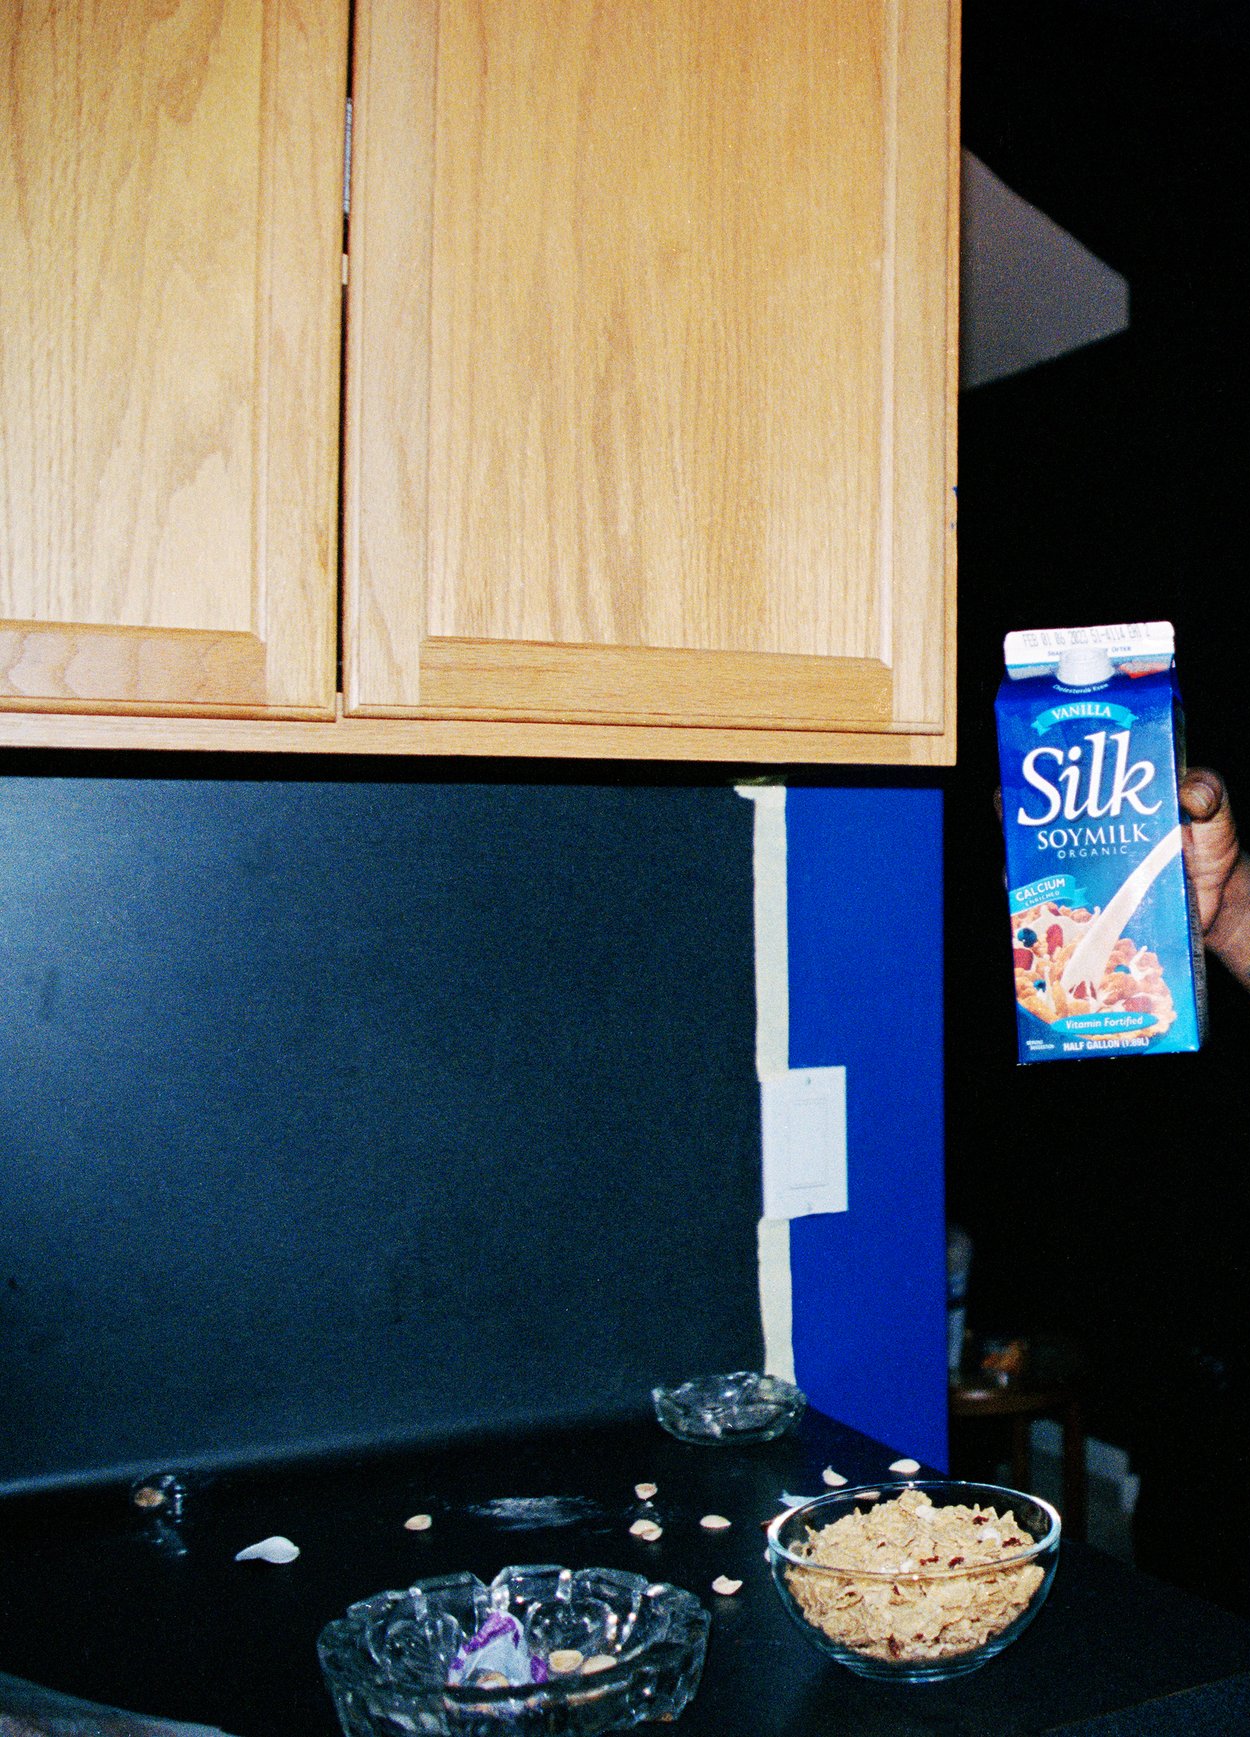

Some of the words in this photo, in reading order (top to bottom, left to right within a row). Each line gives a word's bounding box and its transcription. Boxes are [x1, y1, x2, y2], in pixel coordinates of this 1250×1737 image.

[1052, 704, 1111, 720] VANILLA
[1017, 730, 1163, 826] Silk
[1038, 823, 1151, 850] SOYMILK
[1057, 845, 1129, 860] ORGANIC
[1015, 878, 1066, 902] CALCIUM
[1066, 1018, 1102, 1030] Vitamin
[1104, 1015, 1144, 1028] Fortified
[1063, 1042, 1085, 1052] HALF
[1086, 1039, 1121, 1050] GALLON
